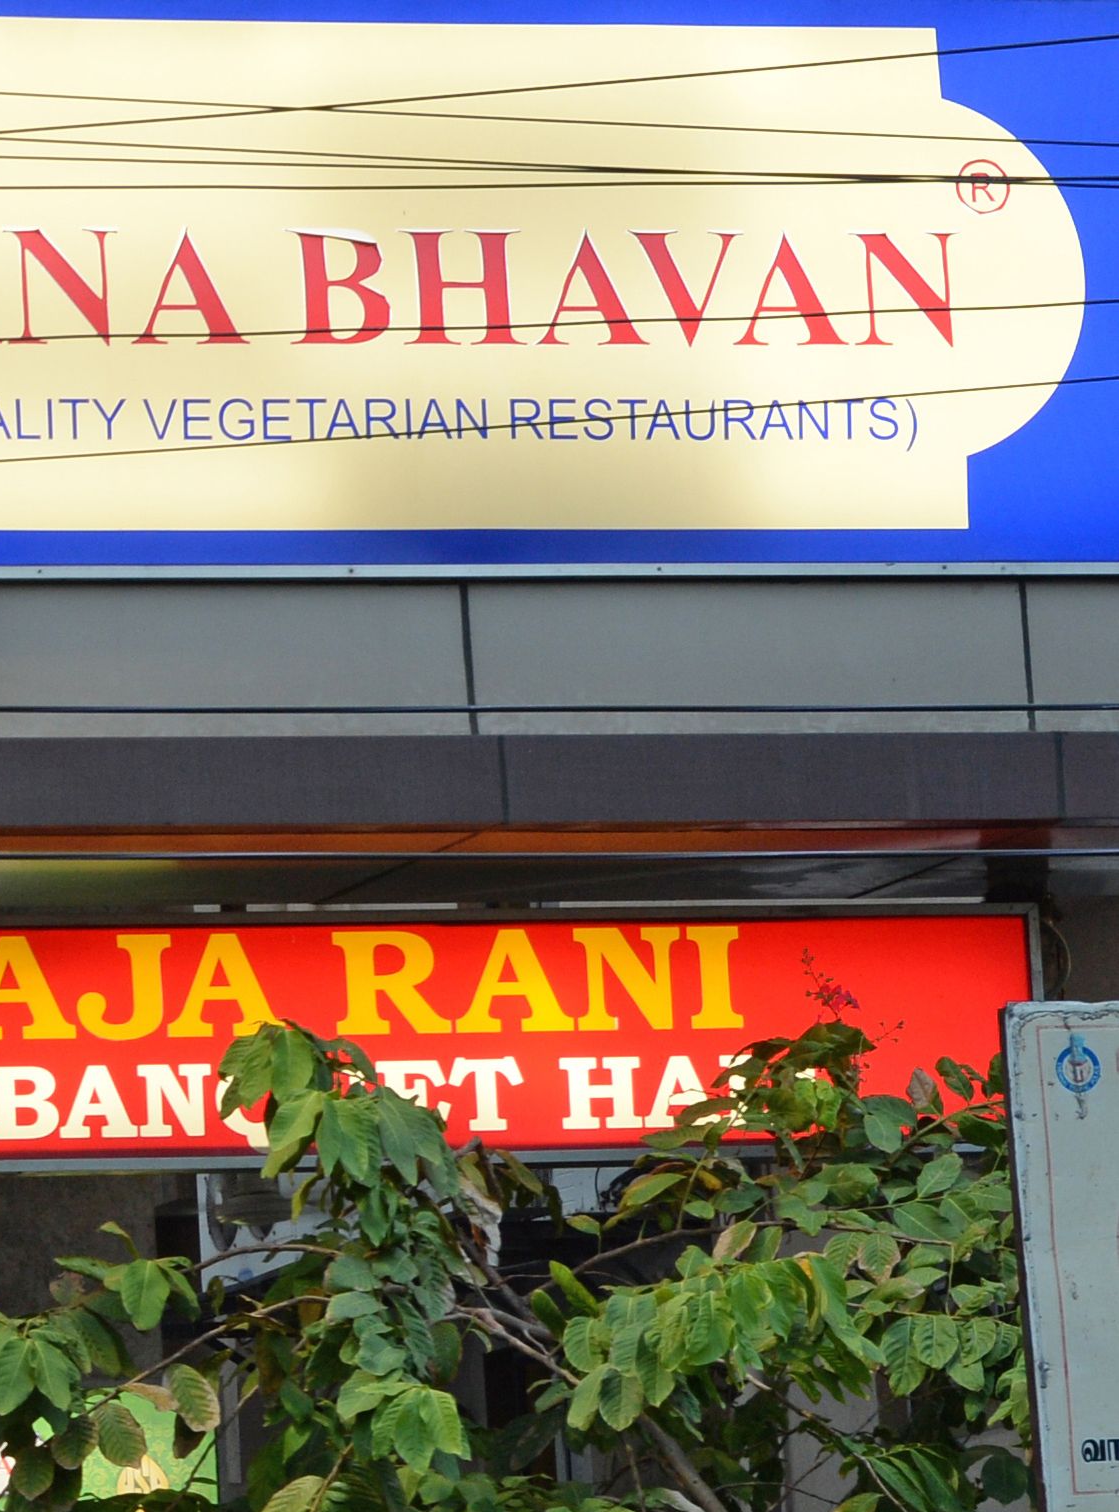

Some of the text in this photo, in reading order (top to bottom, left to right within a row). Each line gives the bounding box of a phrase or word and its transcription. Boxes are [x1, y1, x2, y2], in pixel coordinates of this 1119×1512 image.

[284, 227, 961, 346] BHAVAN
[142, 398, 489, 440] VEGETARIAN
[510, 396, 919, 451] RESTAURANTS)
[331, 926, 745, 1036] RANI
[559, 1054, 832, 1130] HA
